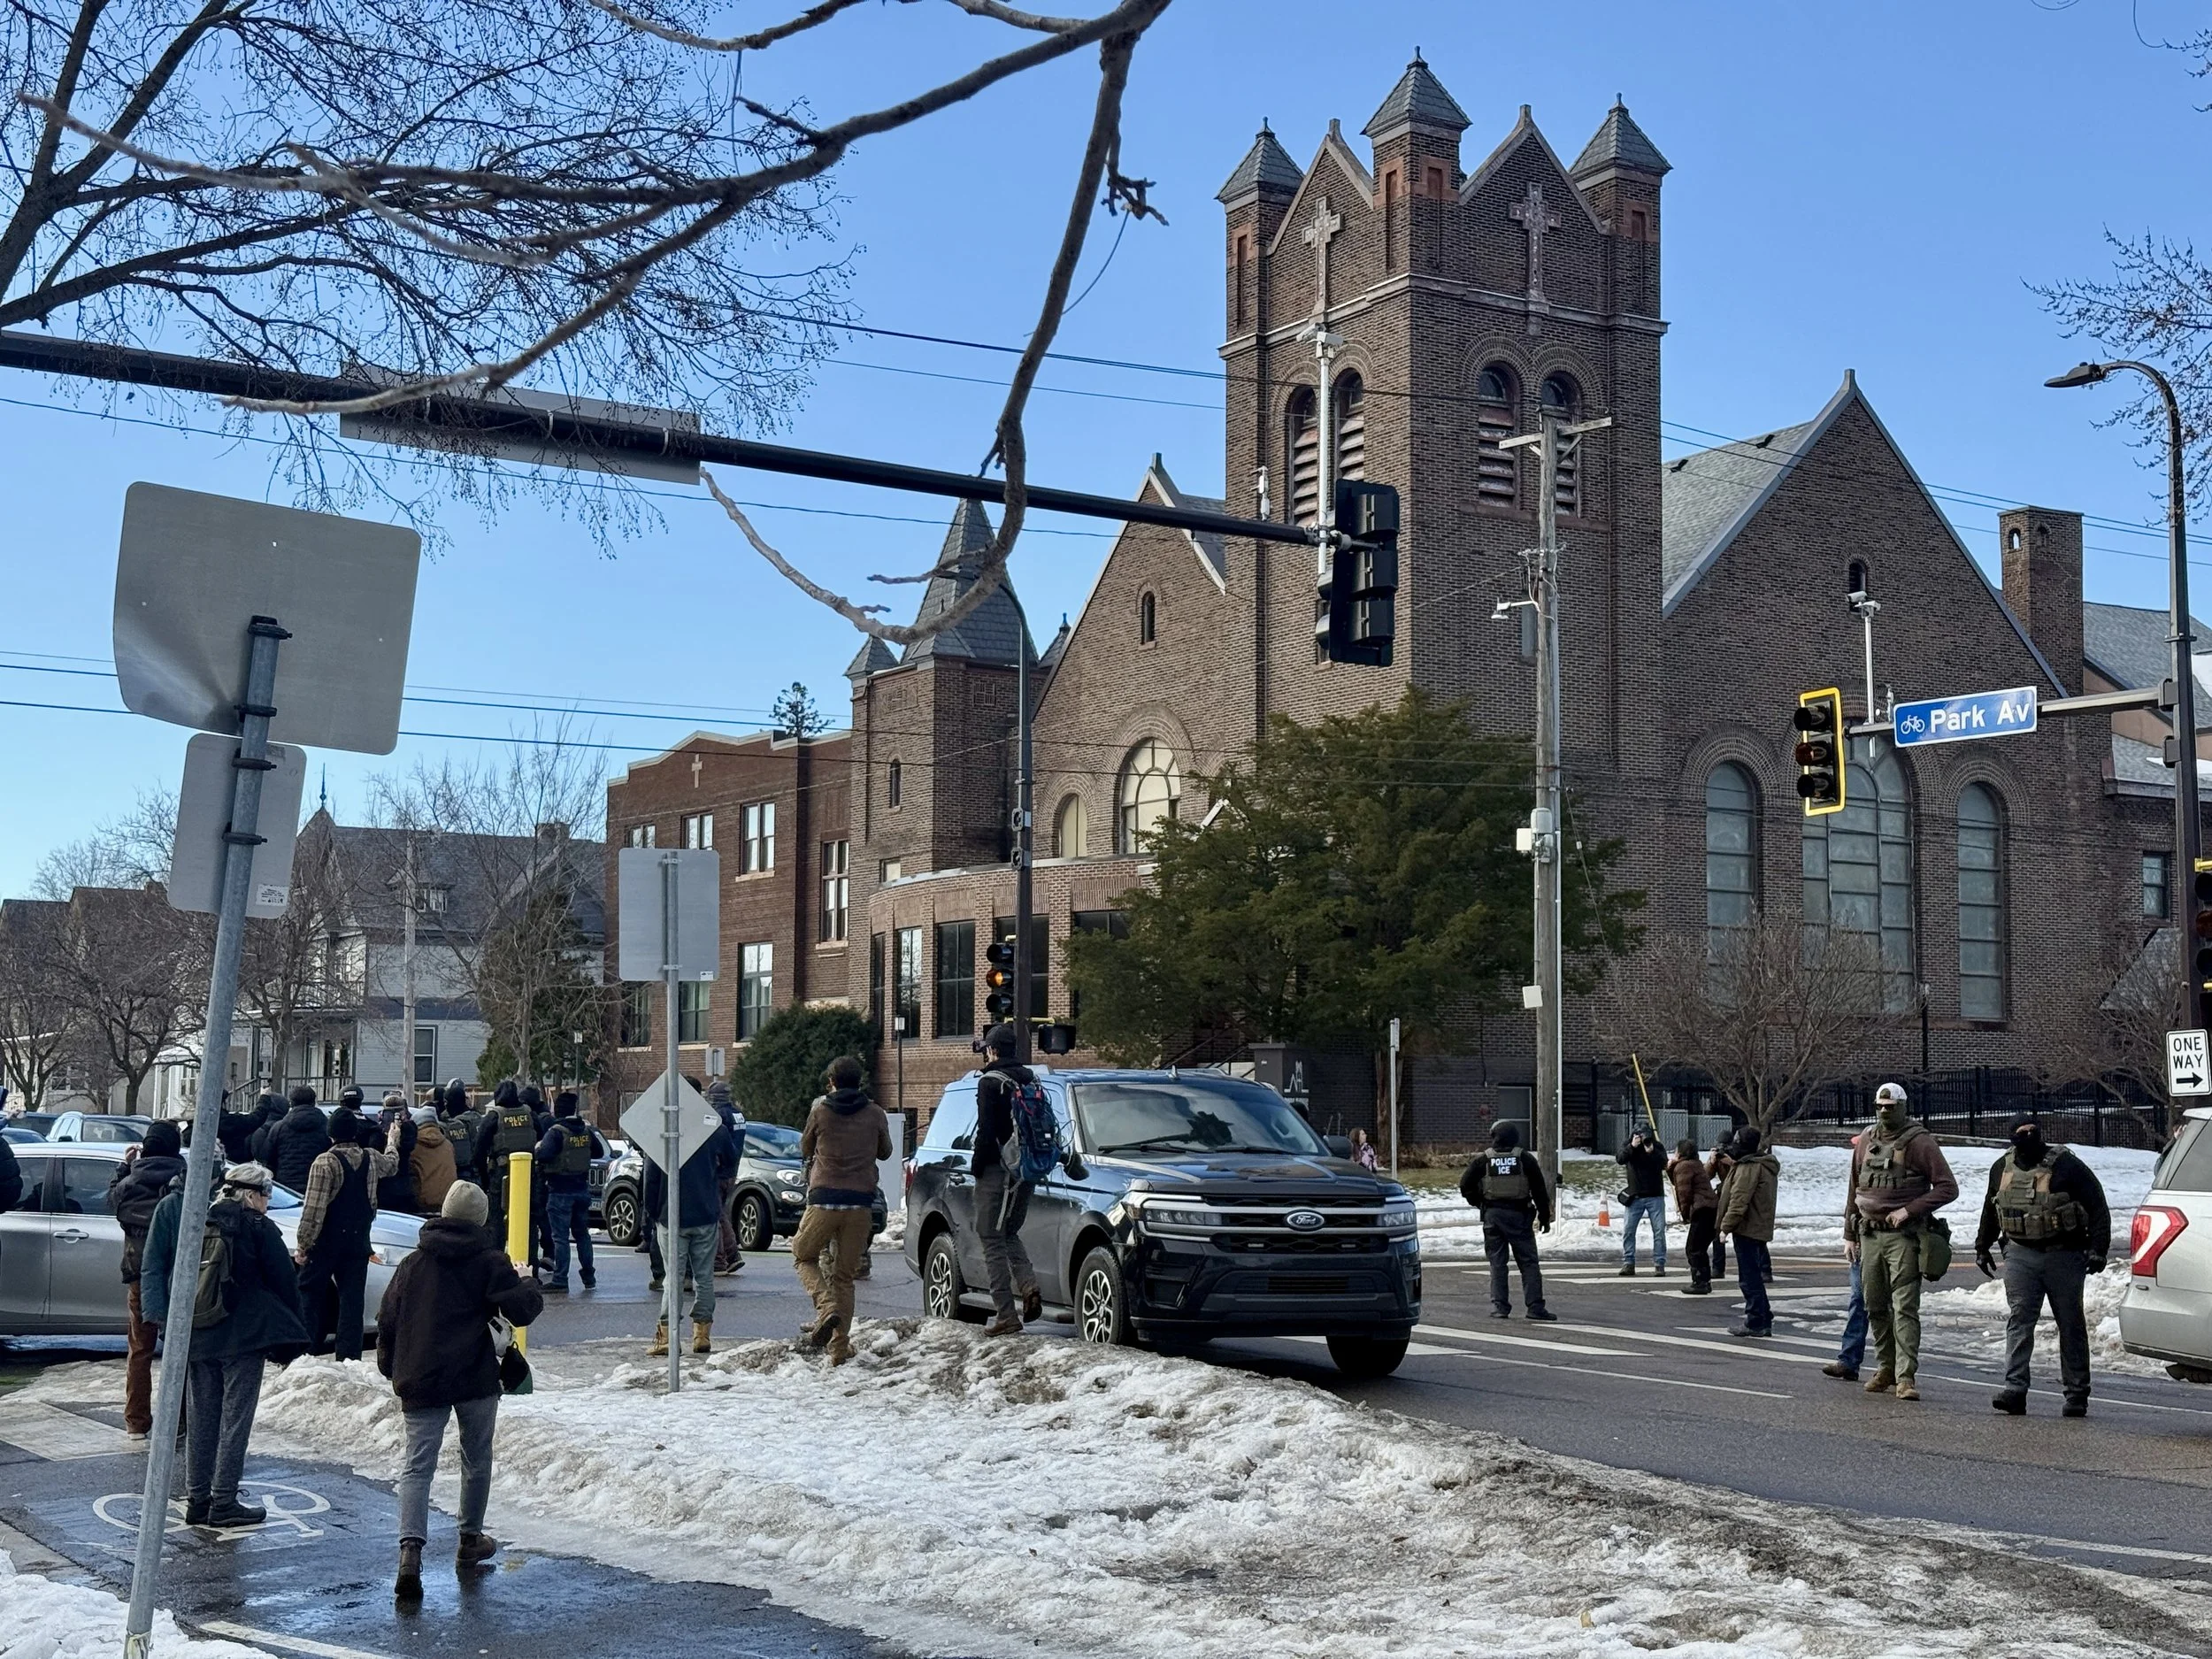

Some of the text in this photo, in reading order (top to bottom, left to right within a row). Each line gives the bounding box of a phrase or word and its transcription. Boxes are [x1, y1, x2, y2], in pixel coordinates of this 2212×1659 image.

[1931, 700, 2030, 733] Park Av
[2173, 1036, 2202, 1052] ONE
[2173, 1053, 2203, 1069] WAY
[1490, 1157, 1517, 1166] POLICE
[1498, 1165, 1510, 1175] ICE
[1296, 1215, 1317, 1225] Ford
